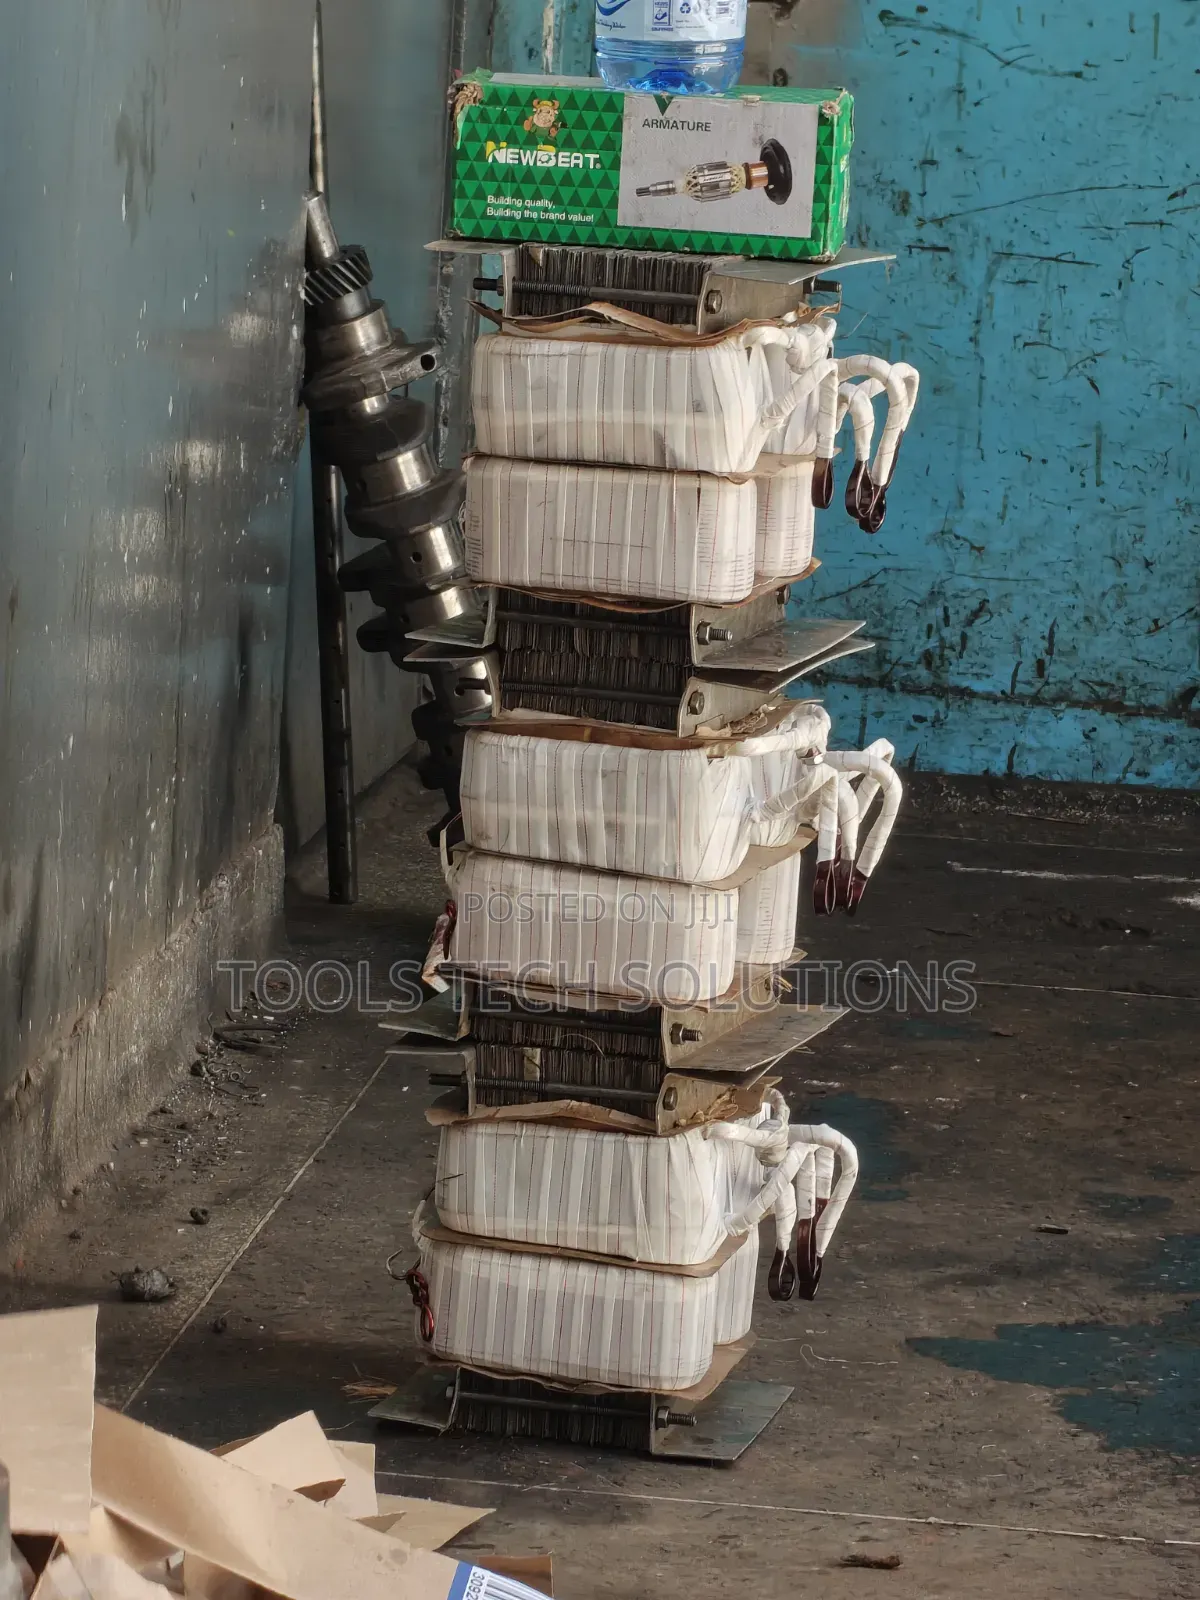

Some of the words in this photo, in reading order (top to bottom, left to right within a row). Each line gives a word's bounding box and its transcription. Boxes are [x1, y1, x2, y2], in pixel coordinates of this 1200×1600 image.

[642, 118, 712, 132] ARMATURE
[487, 195, 523, 207] Building
[525, 198, 556, 208] quality,
[487, 207, 522, 219] Building
[524, 209, 538, 219] the
[540, 211, 566, 221] brand
[567, 213, 594, 222] value!
